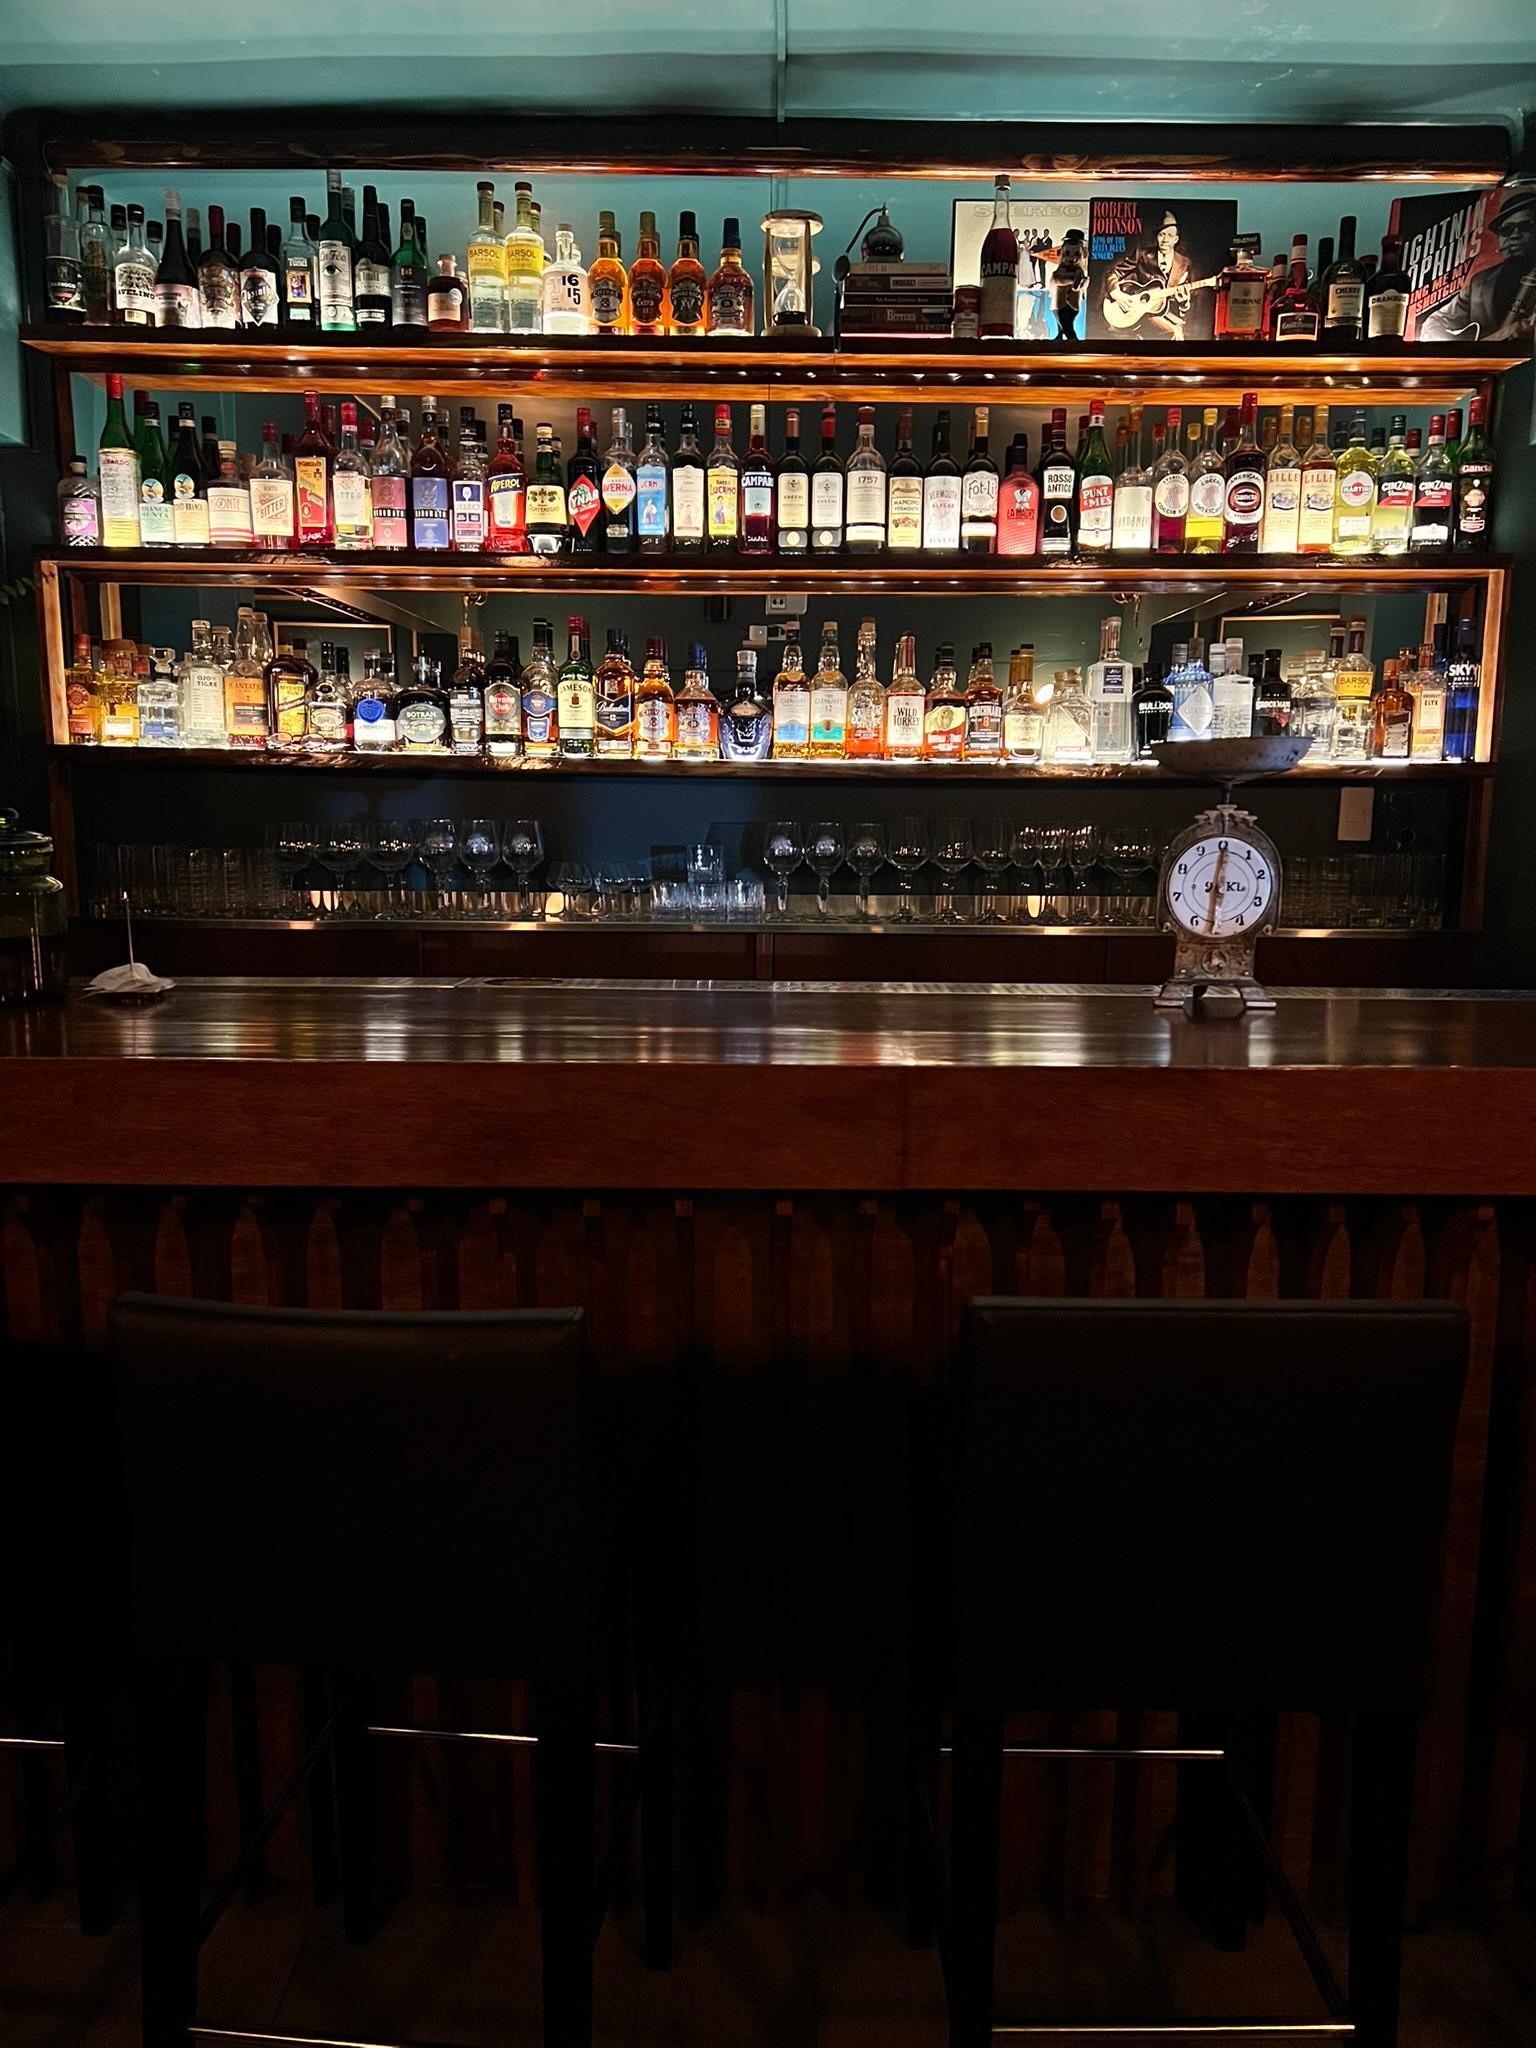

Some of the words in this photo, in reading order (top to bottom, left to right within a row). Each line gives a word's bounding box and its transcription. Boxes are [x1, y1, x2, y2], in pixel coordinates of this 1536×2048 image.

[974, 205, 1083, 217] SEREO
[1093, 201, 1137, 218] ROBERT
[1092, 217, 1143, 236] JOHNSON
[1402, 192, 1495, 271] IGHTNIN'
[982, 262, 1018, 275] CAMPA
[562, 274, 579, 286] 16
[1410, 284, 1429, 303] ING
[1432, 271, 1449, 292] ME
[1452, 258, 1473, 281] MY
[568, 288, 581, 305] 15
[858, 476, 878, 484] 1757
[1047, 474, 1072, 483] ROSSO
[1269, 474, 1298, 482] LILLE
[1305, 474, 1333, 483] LILLE
[491, 479, 520, 491] APEROL
[968, 480, 995, 499] Fot-Li
[1047, 484, 1072, 493] ANTICO
[1083, 486, 1108, 499] PUNT
[1449, 663, 1478, 676] SKYY
[560, 683, 592, 694] JAMESON
[897, 707, 917, 717] WILD
[893, 716, 920, 727] TURKEY
[1245, 850, 1251, 860] 1
[1178, 864, 1187, 874] 8
[1257, 869, 1265, 879] 2
[1173, 892, 1181, 902] 7
[1254, 896, 1262, 907] 3
